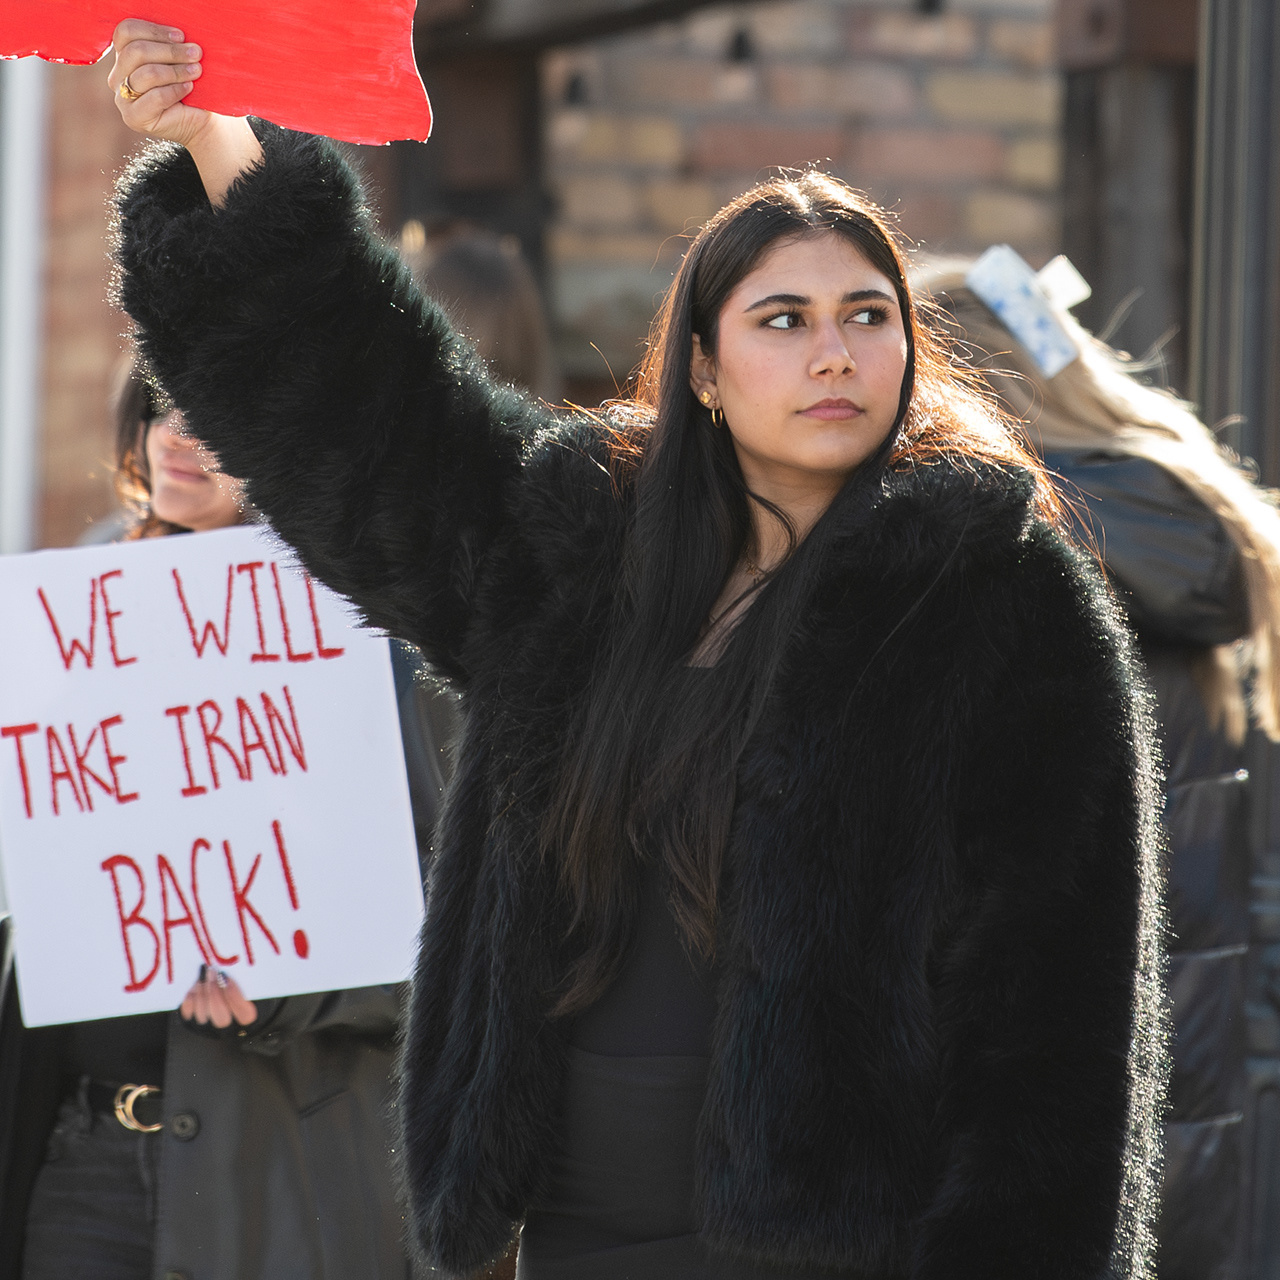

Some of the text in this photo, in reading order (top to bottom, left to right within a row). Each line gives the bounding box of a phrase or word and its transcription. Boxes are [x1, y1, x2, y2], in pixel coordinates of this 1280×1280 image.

[38, 561, 345, 671] WE WILL
[0, 686, 308, 819] TAKE IRAN
[101, 819, 310, 993] BACK!
